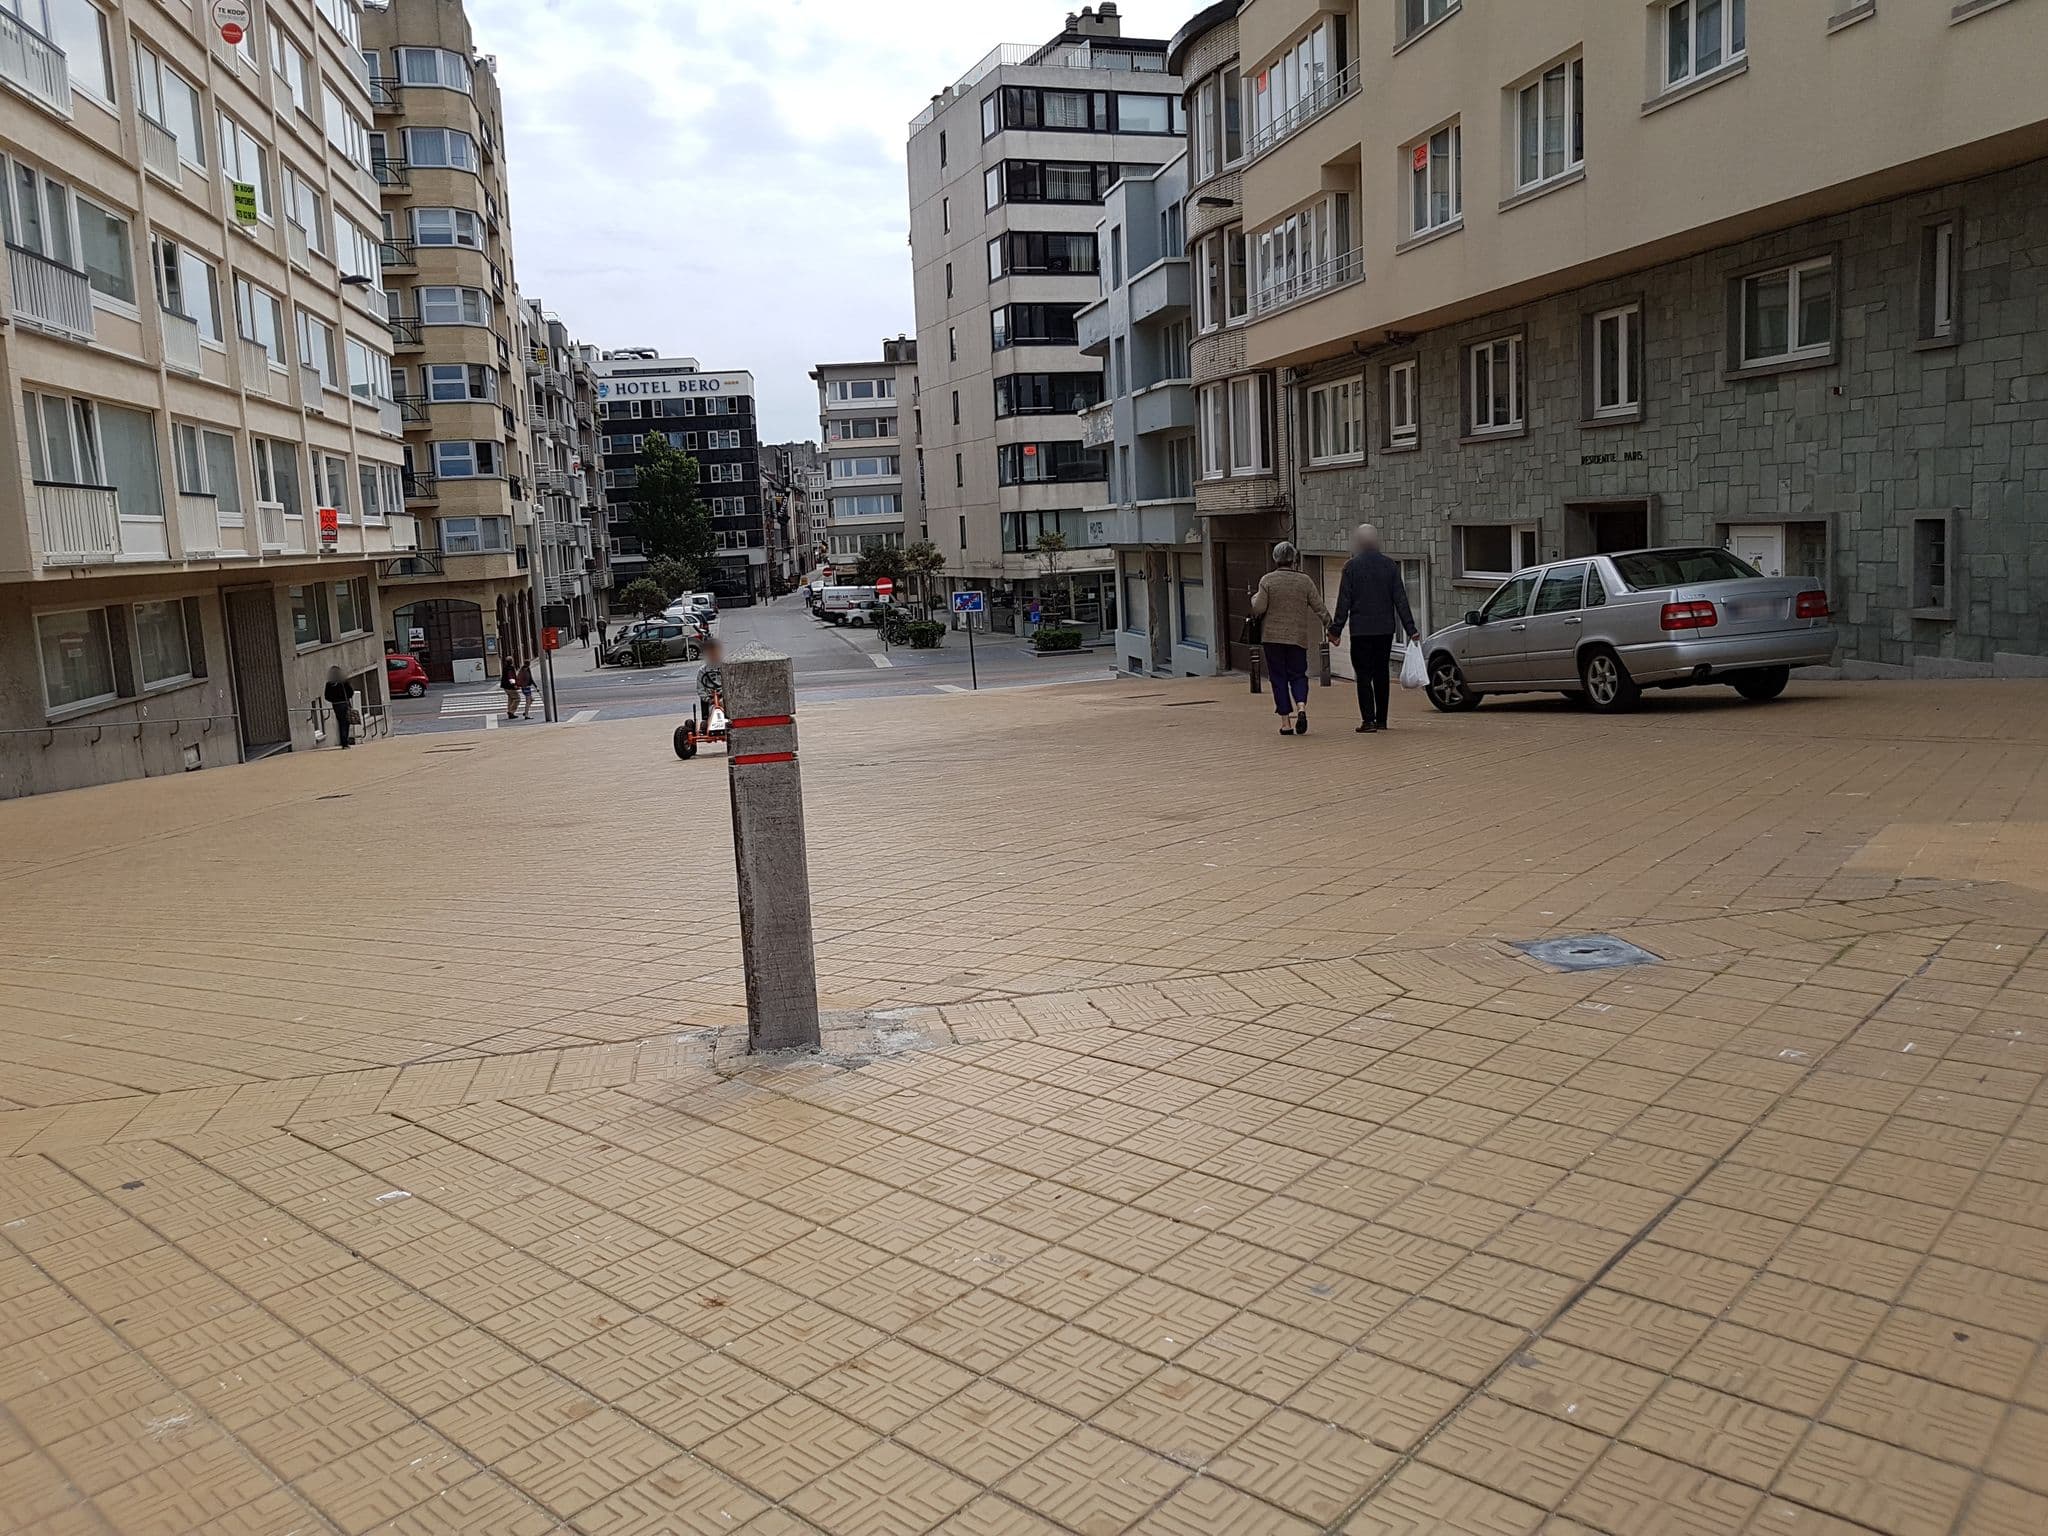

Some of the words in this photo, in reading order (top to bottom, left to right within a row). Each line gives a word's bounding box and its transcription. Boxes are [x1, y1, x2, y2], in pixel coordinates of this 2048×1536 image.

[615, 380, 671, 395] HOTEL
[678, 379, 720, 393] BERO
[1624, 451, 1643, 461] PARIS
